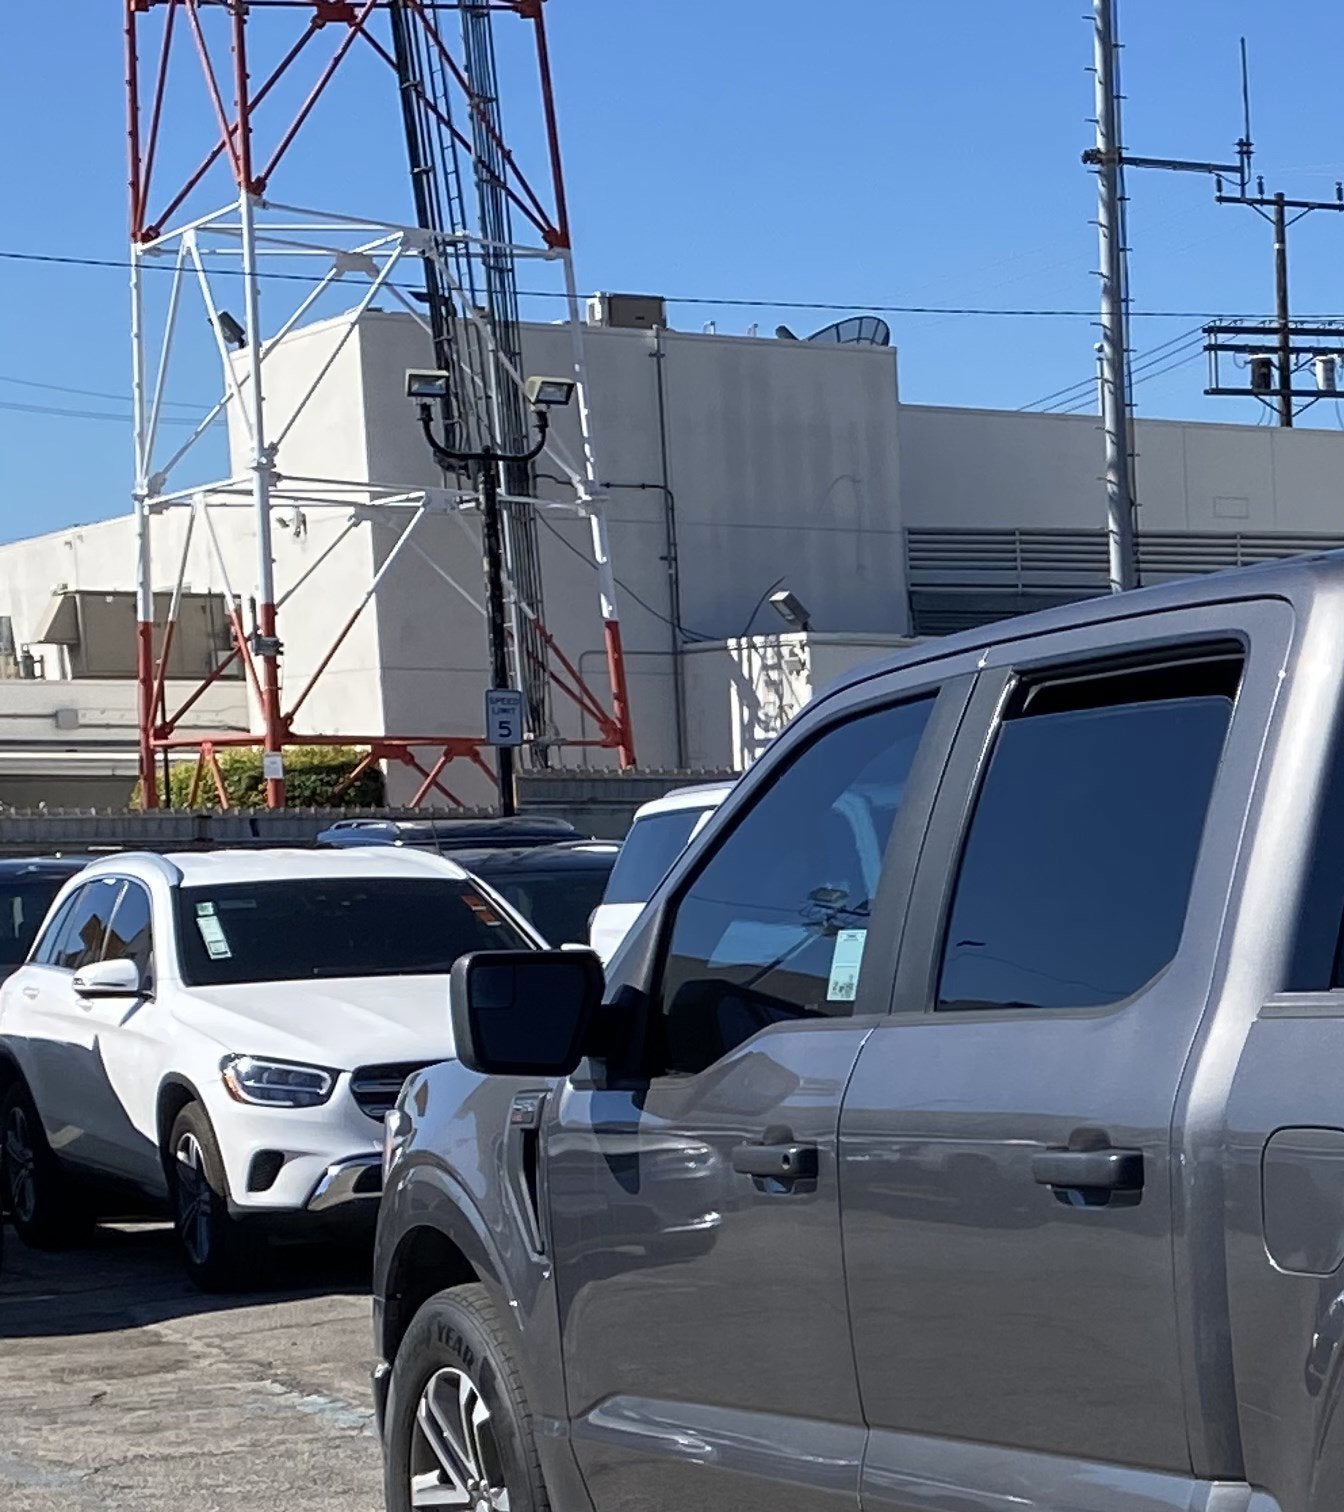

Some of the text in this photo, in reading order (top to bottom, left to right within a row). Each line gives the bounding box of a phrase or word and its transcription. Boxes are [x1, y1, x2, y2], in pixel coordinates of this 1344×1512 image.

[489, 696, 520, 705] SPEED
[492, 706, 516, 715] LIMIT
[498, 720, 512, 738] 5
